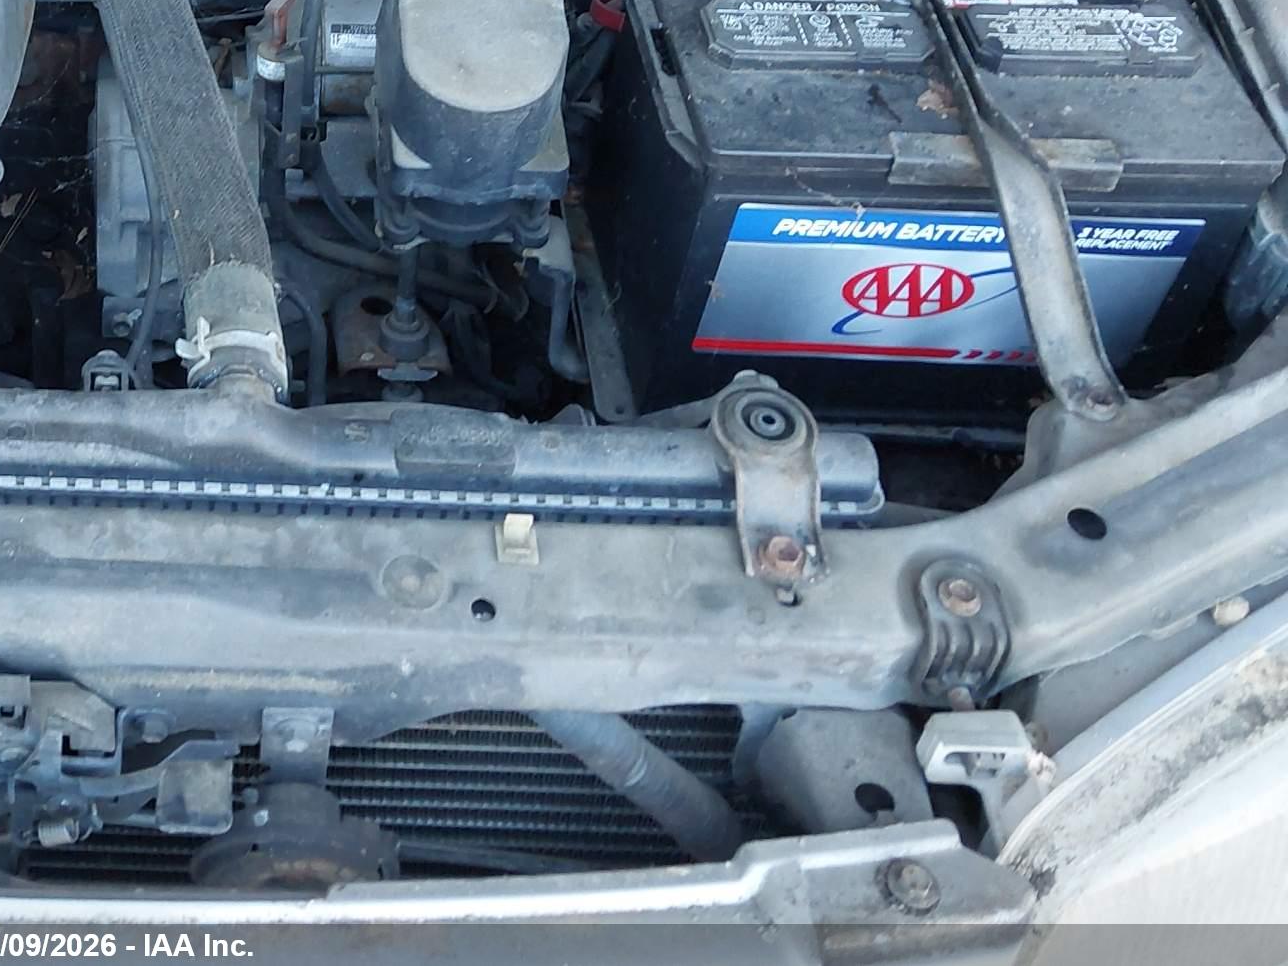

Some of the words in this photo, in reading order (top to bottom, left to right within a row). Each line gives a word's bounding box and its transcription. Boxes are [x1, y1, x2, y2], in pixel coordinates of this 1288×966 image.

[753, 1, 813, 11] DANGER
[825, 2, 881, 13] POISON
[772, 218, 898, 240] PREMIUM
[895, 222, 1005, 243] BATTERY
[1092, 228, 1138, 240] YEAR
[1134, 229, 1180, 242] FREE
[1074, 237, 1169, 251] REPLACEMENT
[846, 264, 970, 318] AAA
